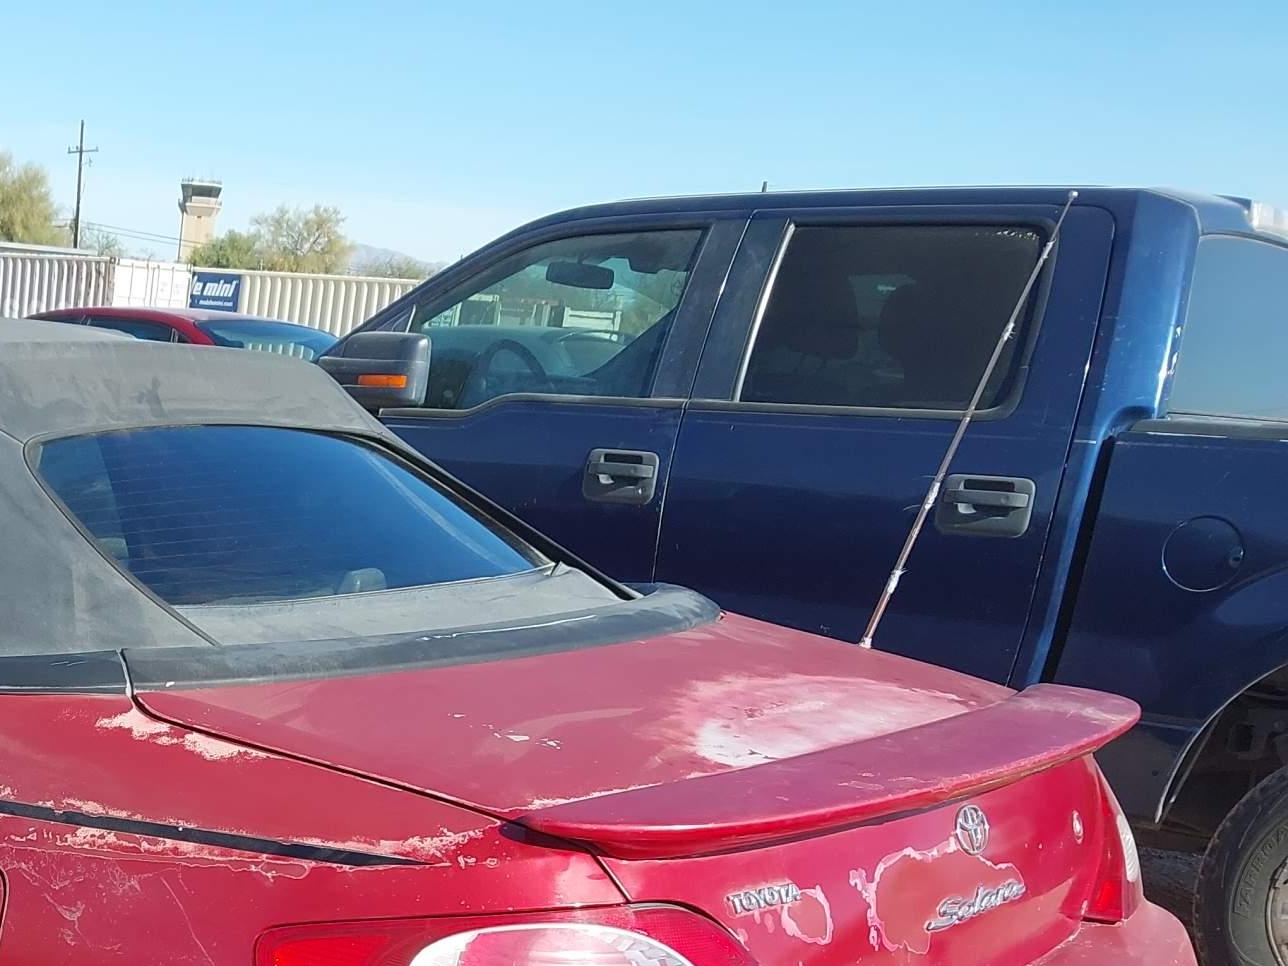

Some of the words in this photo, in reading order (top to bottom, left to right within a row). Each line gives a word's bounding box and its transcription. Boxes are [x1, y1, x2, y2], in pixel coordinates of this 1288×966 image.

[203, 279, 238, 298] mini
[725, 882, 802, 915] TOYOTA
[923, 878, 1027, 933] Solara
